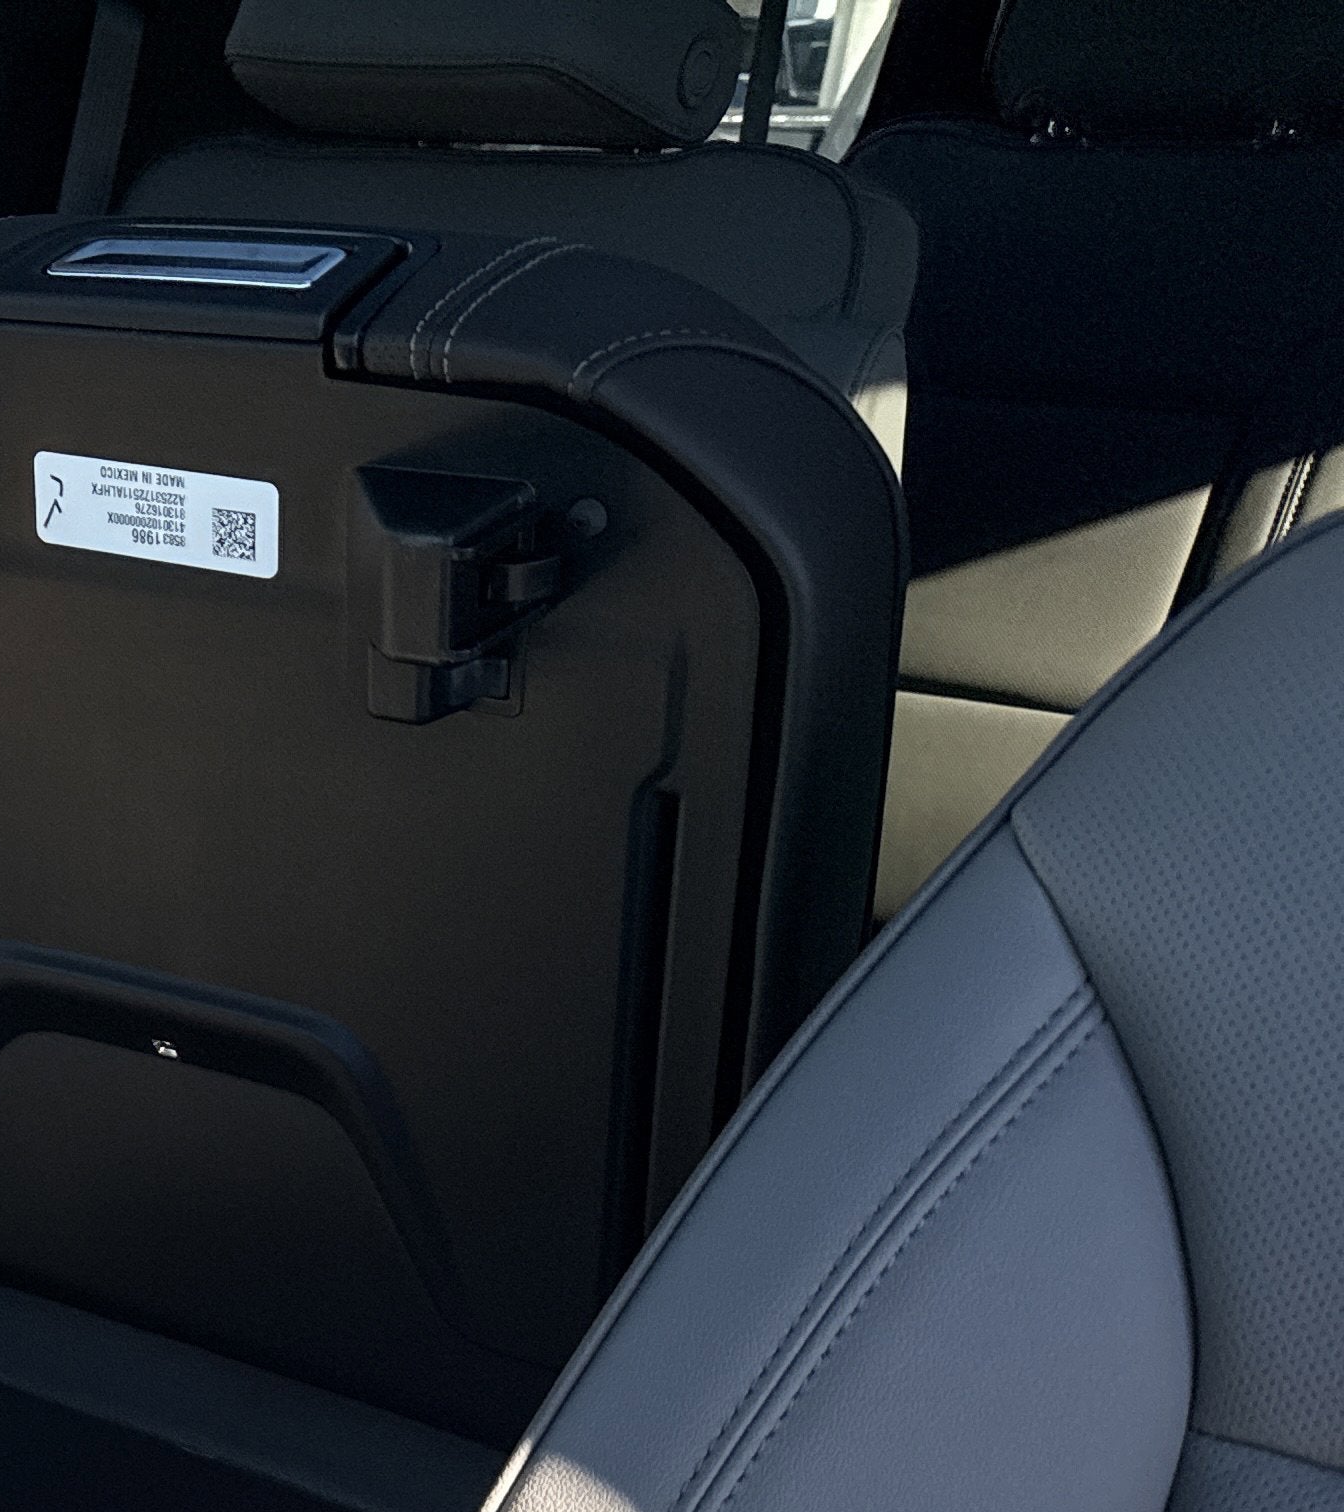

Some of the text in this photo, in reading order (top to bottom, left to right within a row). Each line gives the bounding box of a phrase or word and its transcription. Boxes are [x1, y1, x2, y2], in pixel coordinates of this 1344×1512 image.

[99, 465, 185, 488] MADE IN MEXICO
